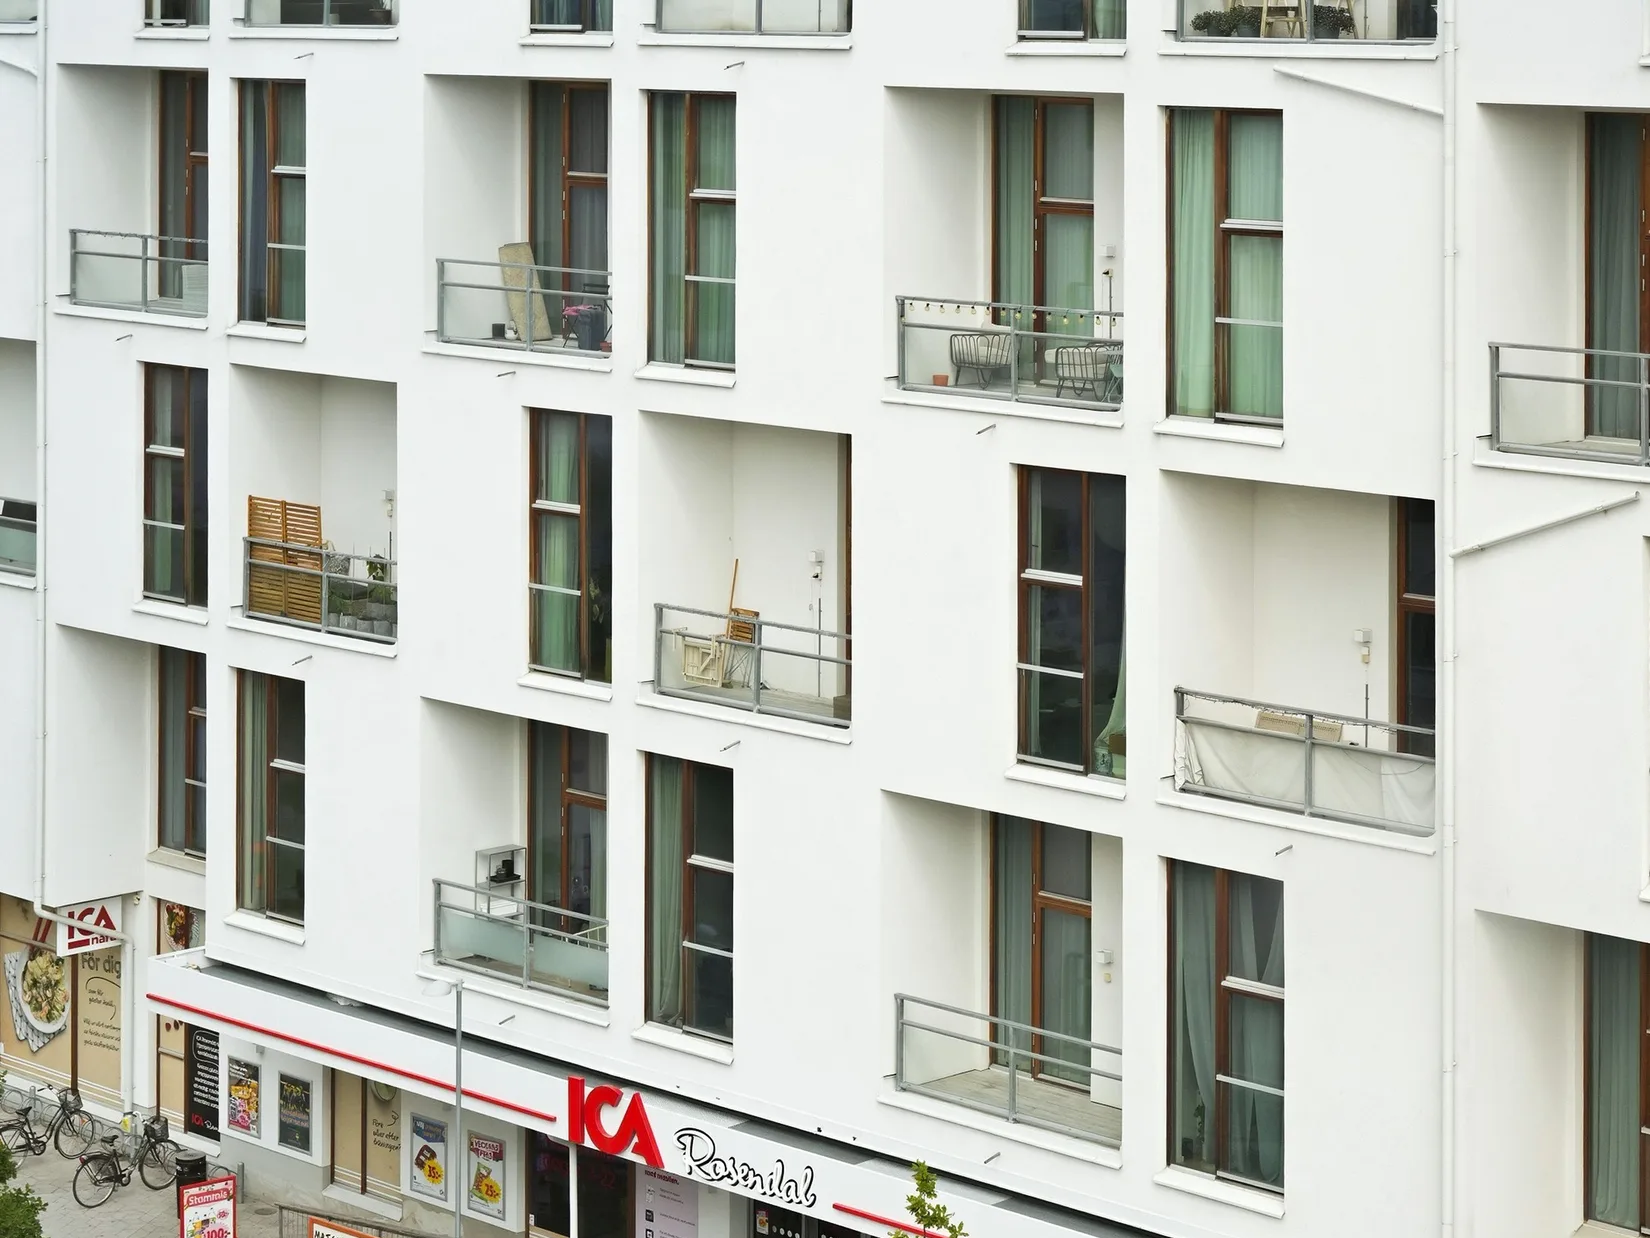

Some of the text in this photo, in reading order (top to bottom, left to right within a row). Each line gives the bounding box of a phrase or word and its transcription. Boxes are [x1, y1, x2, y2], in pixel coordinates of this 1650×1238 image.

[68, 905, 117, 940] ICA
[568, 1076, 665, 1169] ICA
[673, 1127, 817, 1207] Rosendal
[188, 1189, 228, 1206] Stammis
